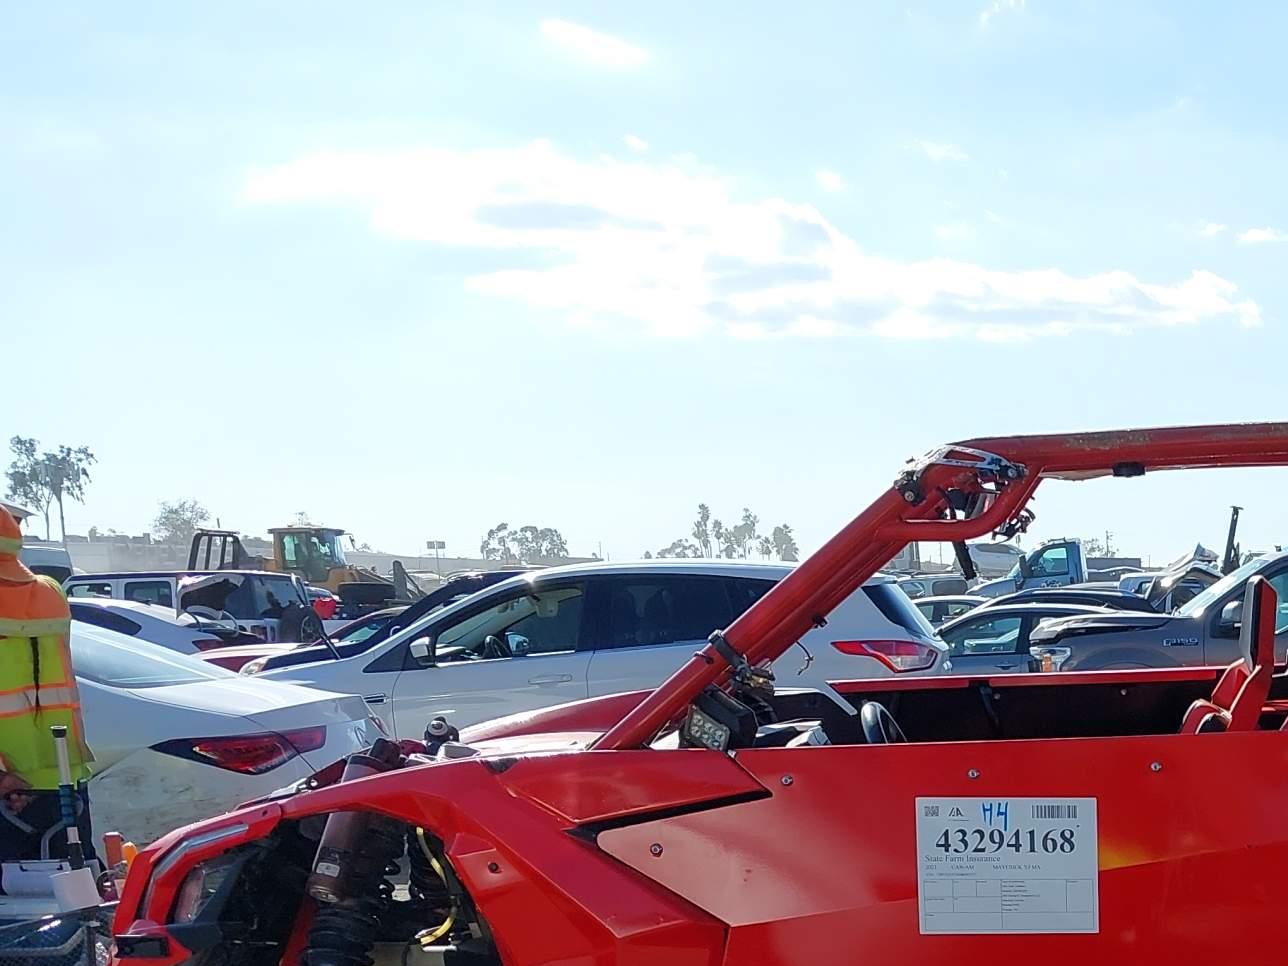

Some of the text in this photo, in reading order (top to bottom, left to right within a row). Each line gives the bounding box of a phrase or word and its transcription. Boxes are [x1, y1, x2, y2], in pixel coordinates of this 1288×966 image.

[935, 828, 1076, 854] 43294168
[924, 854, 1001, 863] State Farm Insurance
